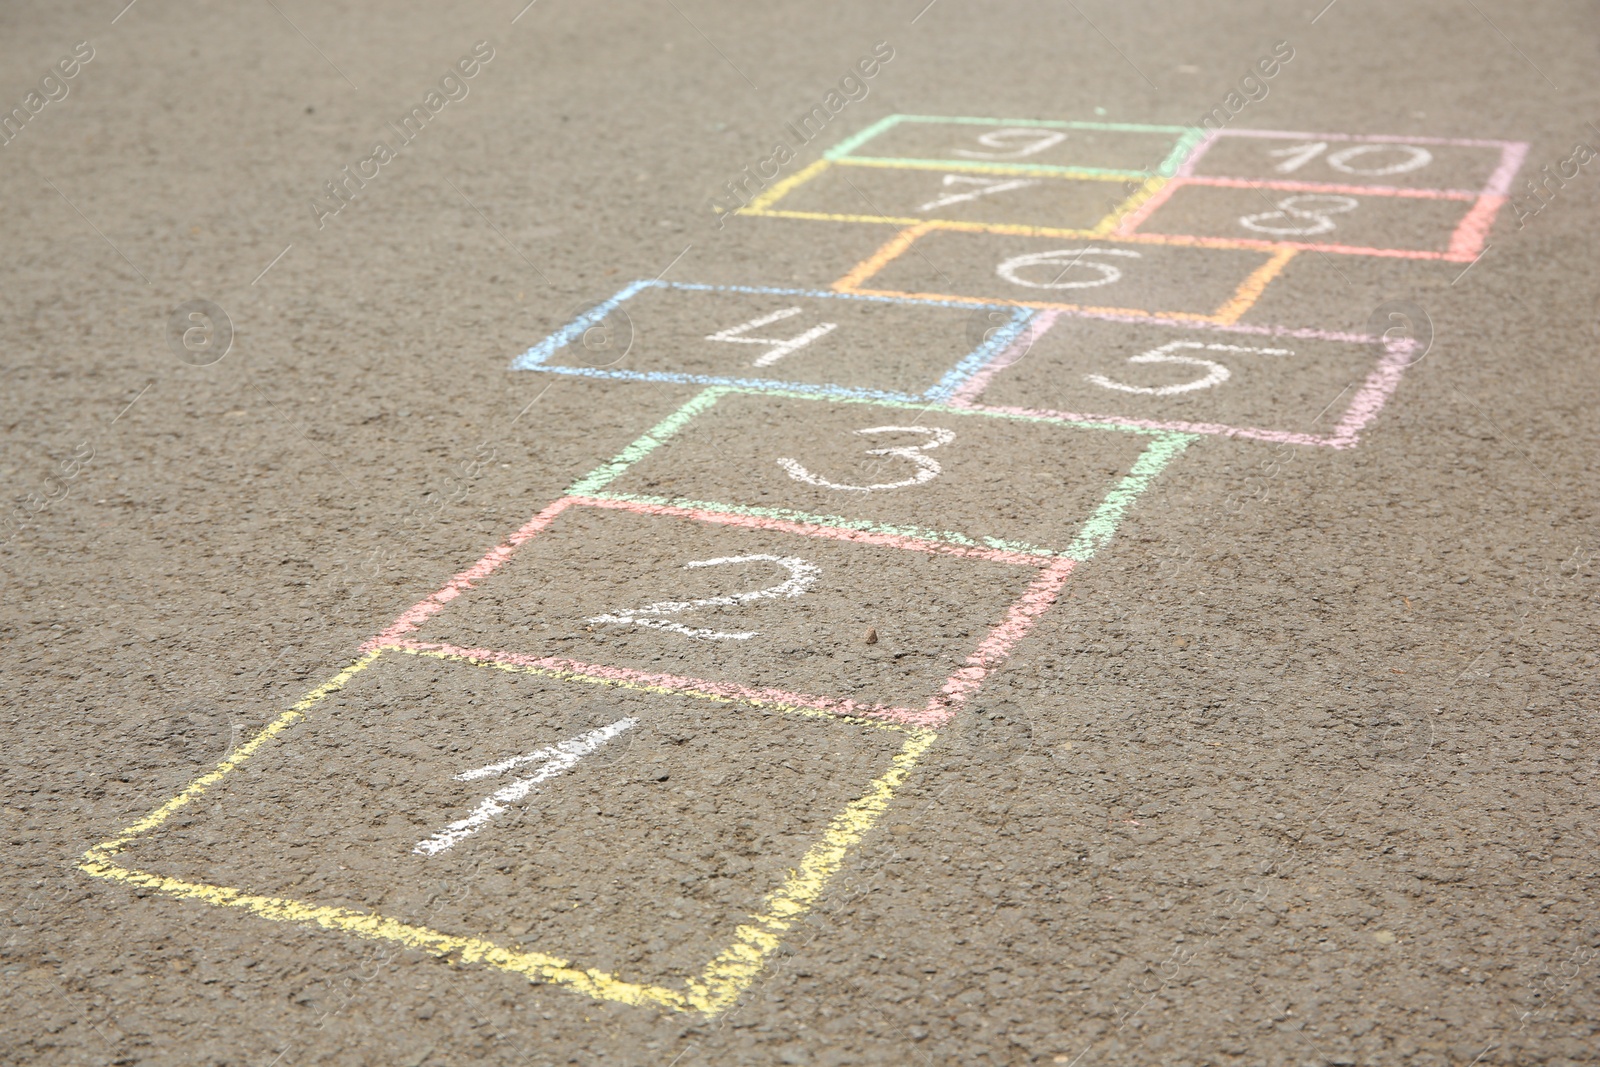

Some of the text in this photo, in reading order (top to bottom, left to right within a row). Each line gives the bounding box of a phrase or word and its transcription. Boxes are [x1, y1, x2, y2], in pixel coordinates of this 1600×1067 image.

[952, 128, 1067, 159] 9
[1268, 141, 1433, 176] 10
[918, 173, 1035, 211] 7
[1239, 194, 1358, 236] 8
[996, 247, 1141, 290] 6
[706, 306, 837, 368] 4
[1084, 341, 1293, 397] 5
[776, 424, 957, 494] 3
[586, 553, 823, 641] 2
[412, 716, 640, 856] 1
